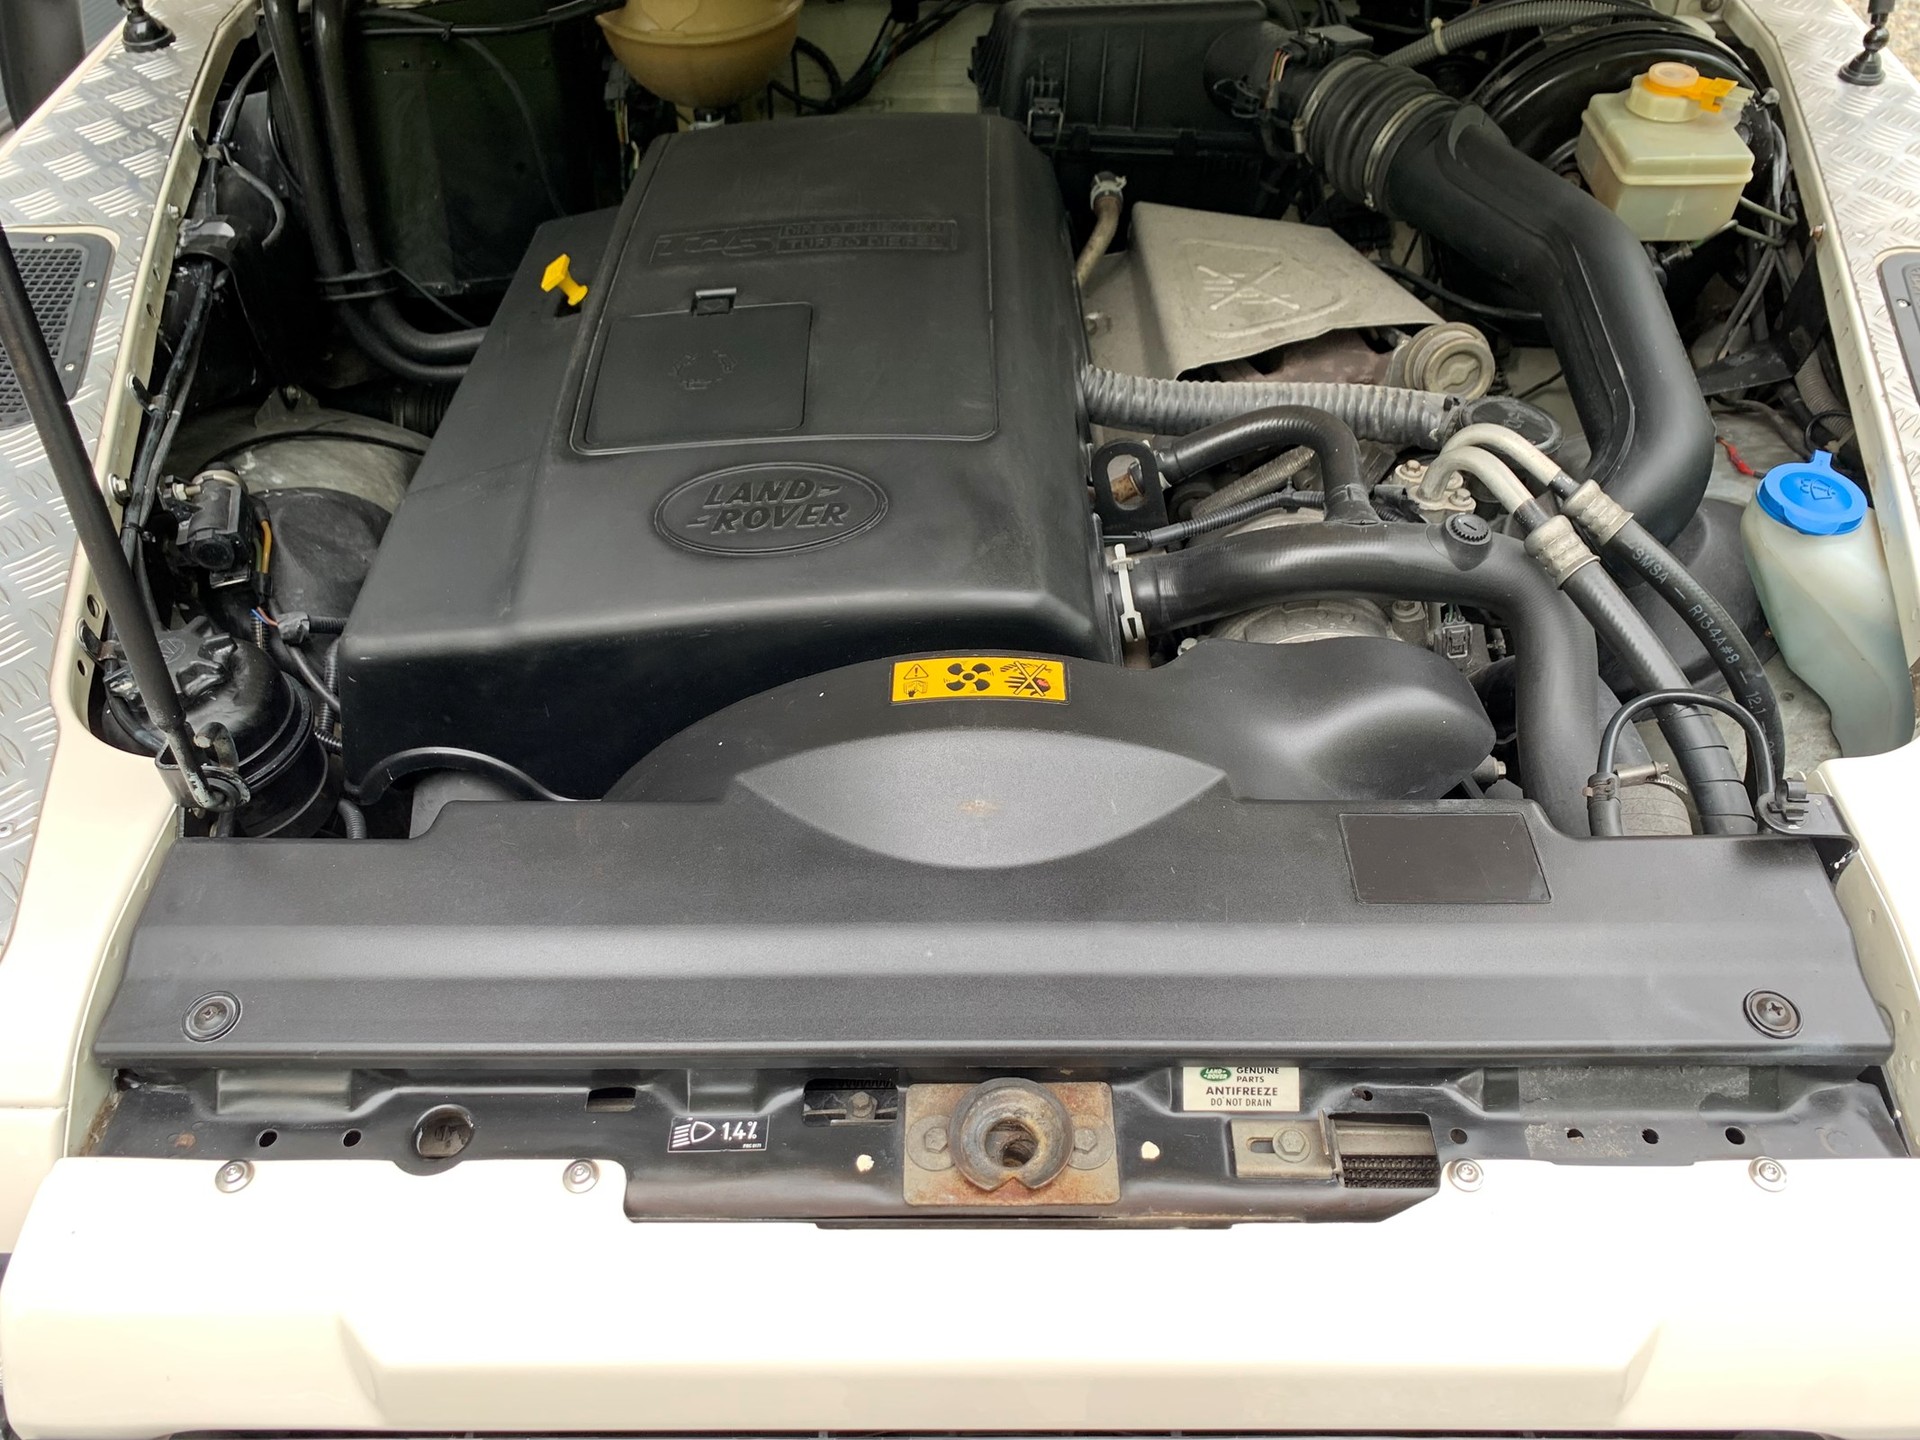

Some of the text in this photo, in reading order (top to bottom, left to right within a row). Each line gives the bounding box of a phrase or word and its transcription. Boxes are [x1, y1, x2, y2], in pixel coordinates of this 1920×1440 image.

[1236, 1066, 1280, 1075] GENUINE
[1236, 1075, 1265, 1083] PARTS
[1206, 1086, 1278, 1096] ANTIFREEZE
[1210, 1098, 1272, 1107] DO NOT DRAIN
